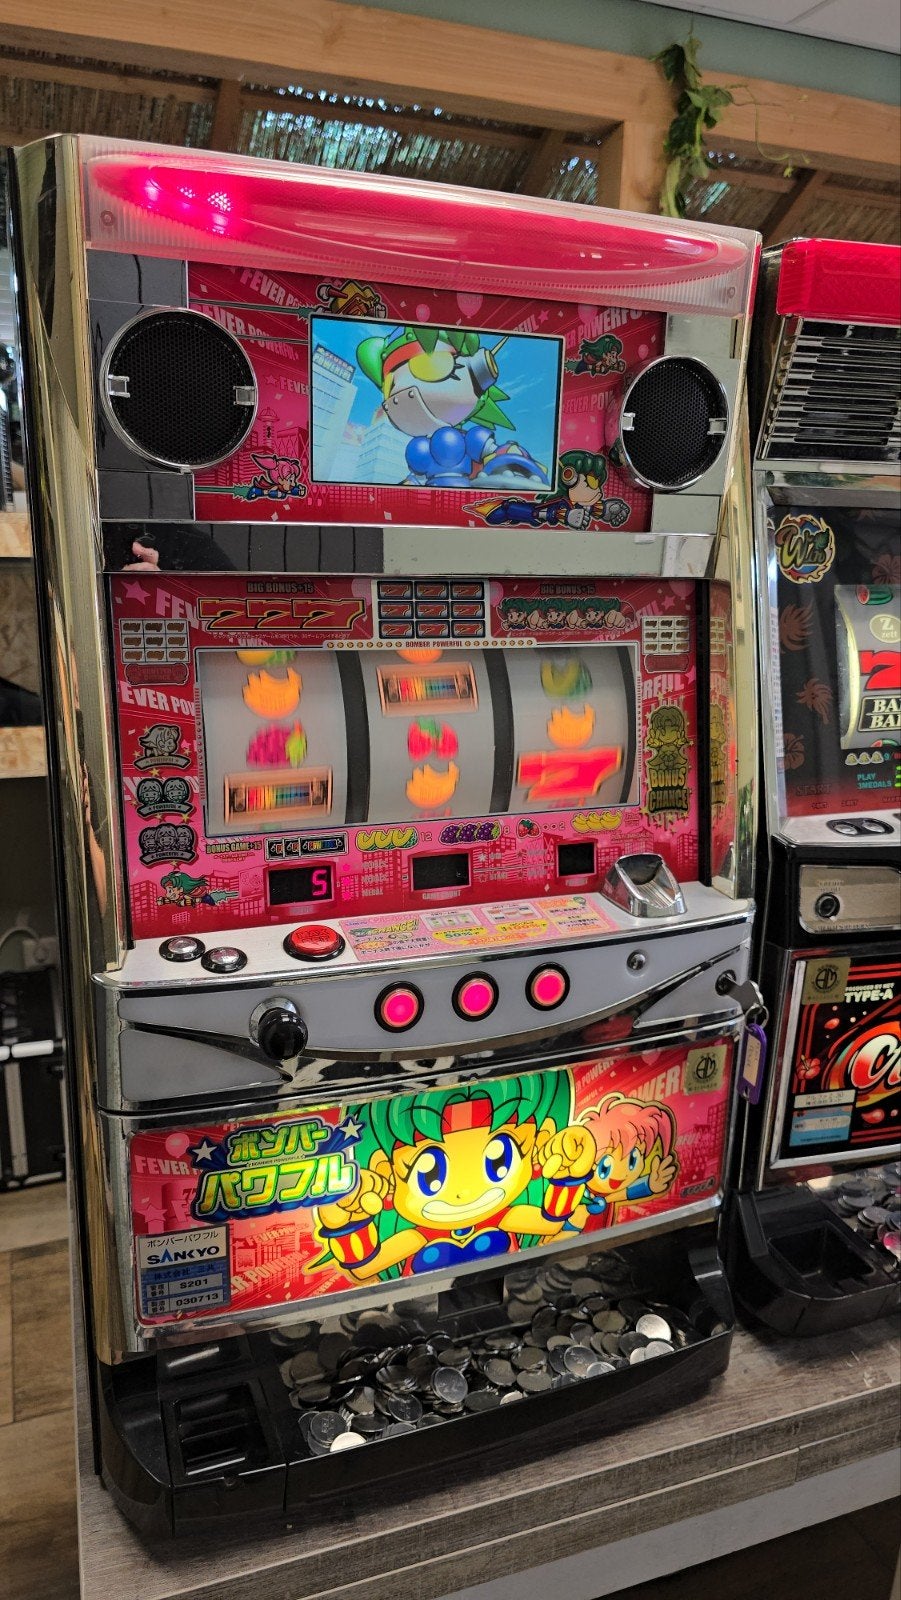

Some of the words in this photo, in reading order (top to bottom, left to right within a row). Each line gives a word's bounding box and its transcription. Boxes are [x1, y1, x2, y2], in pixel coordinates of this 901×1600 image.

[247, 582, 264, 593] BIG
[432, 640, 463, 648] POWERFUL
[117, 681, 170, 711] EVER
[872, 698, 901, 713] BA
[649, 766, 687, 789] BONUS
[856, 773, 876, 781] PLAY
[649, 788, 689, 813] CHANCE
[206, 845, 230, 854] BONUS
[311, 868, 328, 897] 5
[844, 988, 894, 1003] TYPE-A
[230, 1121, 328, 1162] ボンバー
[134, 1154, 190, 1175] FEVER
[199, 1153, 354, 1209] パワフル
[147, 1231, 219, 1248] ボンバーパワフル
[147, 1245, 220, 1265] SANKYO
[180, 1278, 208, 1289] S201
[176, 1293, 219, 1307] 030713
